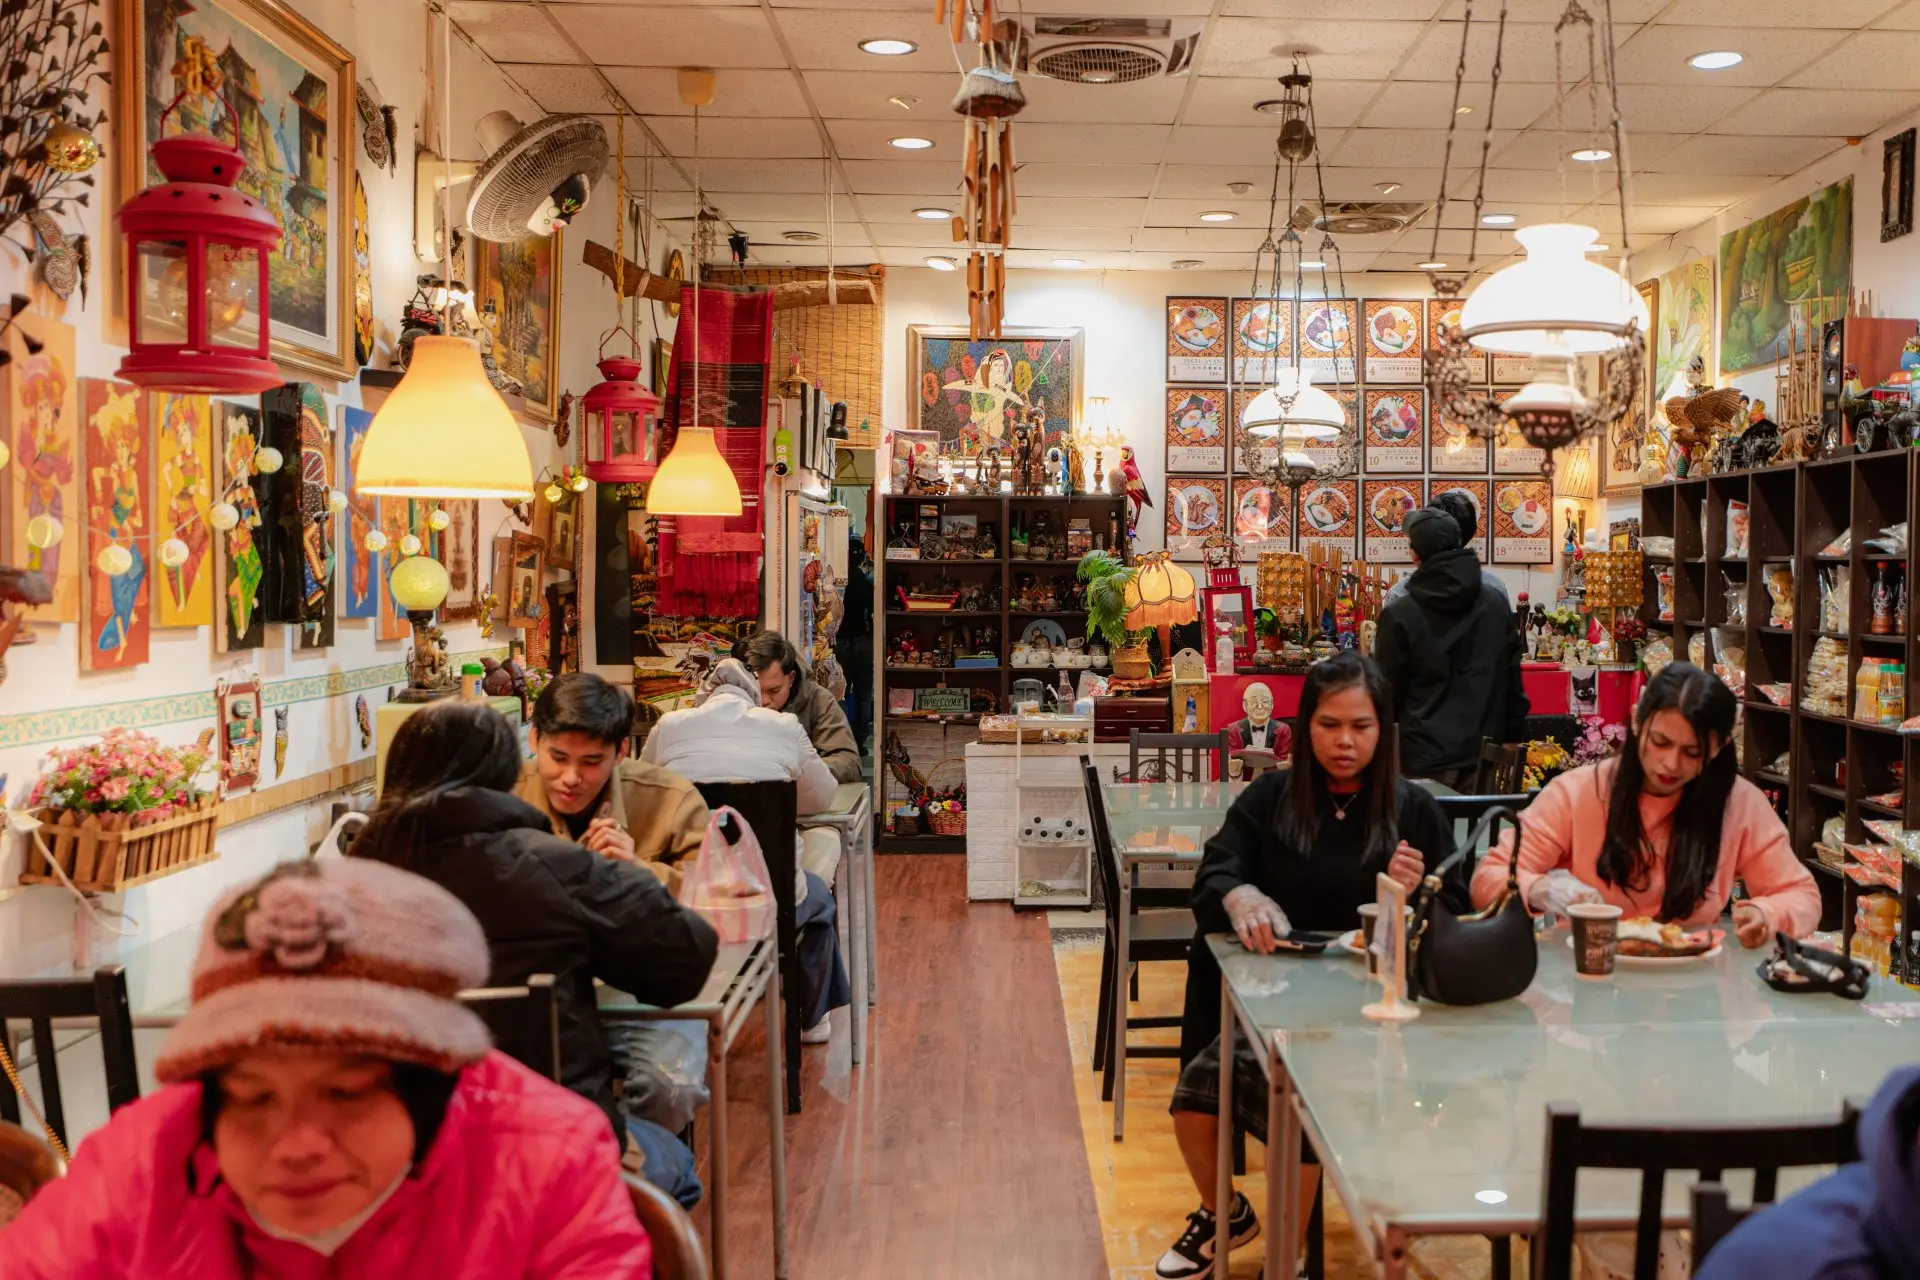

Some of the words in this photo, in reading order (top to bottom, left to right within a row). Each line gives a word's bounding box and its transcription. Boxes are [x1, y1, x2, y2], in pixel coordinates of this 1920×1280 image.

[1171, 365, 1178, 376] 1
[1369, 365, 1376, 376] 4
[1496, 366, 1504, 377] 6
[1171, 454, 1178, 465] 7
[1368, 456, 1380, 466] 10
[1434, 456, 1444, 466] 11
[1367, 546, 1379, 556] 16
[1495, 547, 1507, 556] 18
[923, 696, 963, 707] WELCOME
